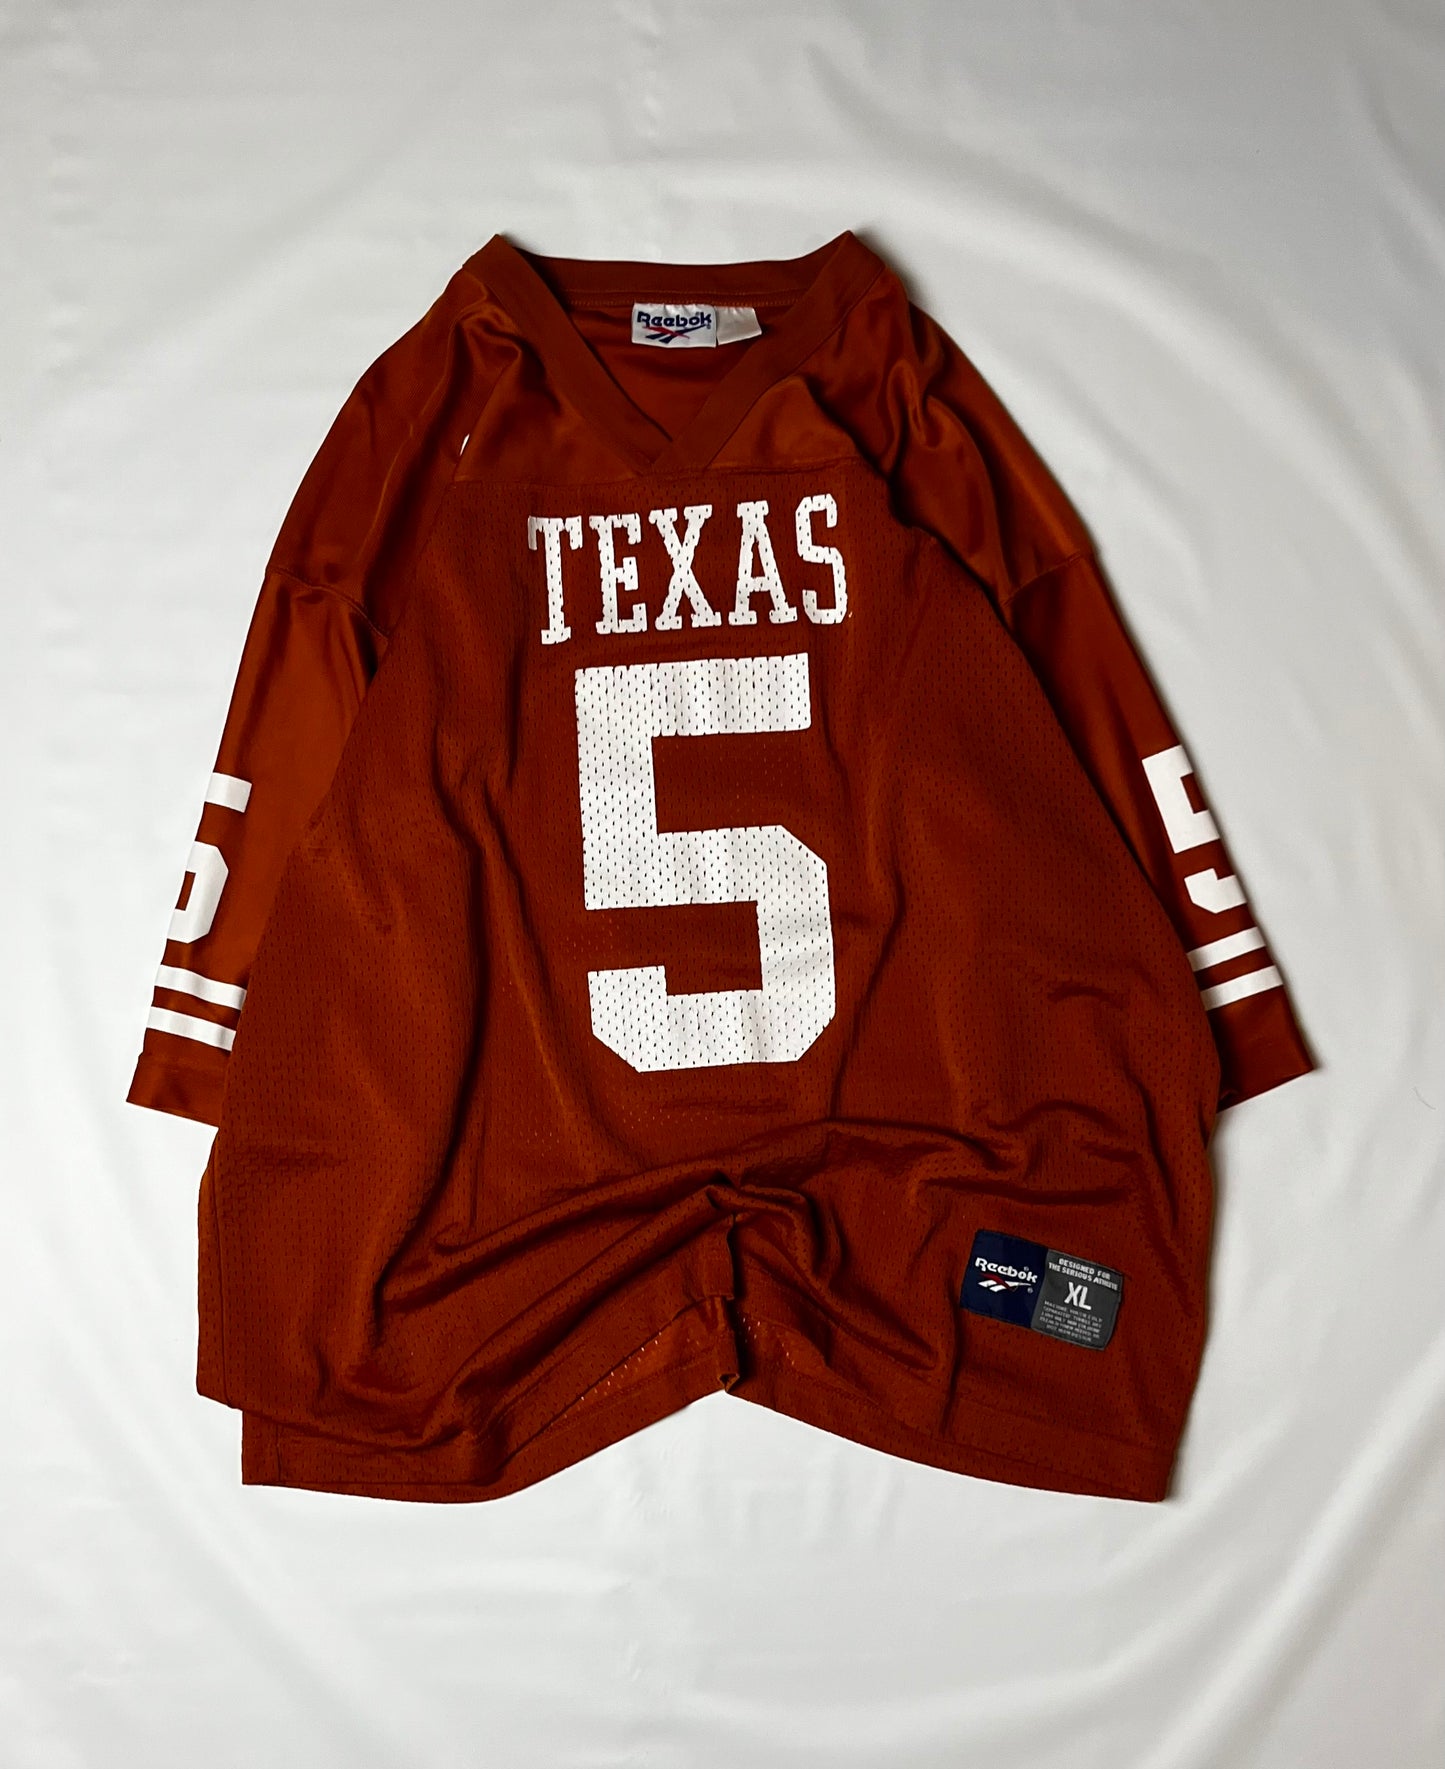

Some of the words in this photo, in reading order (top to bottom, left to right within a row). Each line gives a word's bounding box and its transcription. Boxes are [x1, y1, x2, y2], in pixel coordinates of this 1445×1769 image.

[636, 311, 713, 329] Reebok
[527, 494, 848, 646] TEXAS
[574, 652, 836, 1073] 5
[974, 1257, 1039, 1284] Reebok
[1048, 1262, 1062, 1272] THE
[1062, 1266, 1093, 1282] SERIOUS
[1058, 1258, 1096, 1275] DESIGNED
[1097, 1270, 1112, 1281] FOR
[1064, 1281, 1092, 1311] XL
